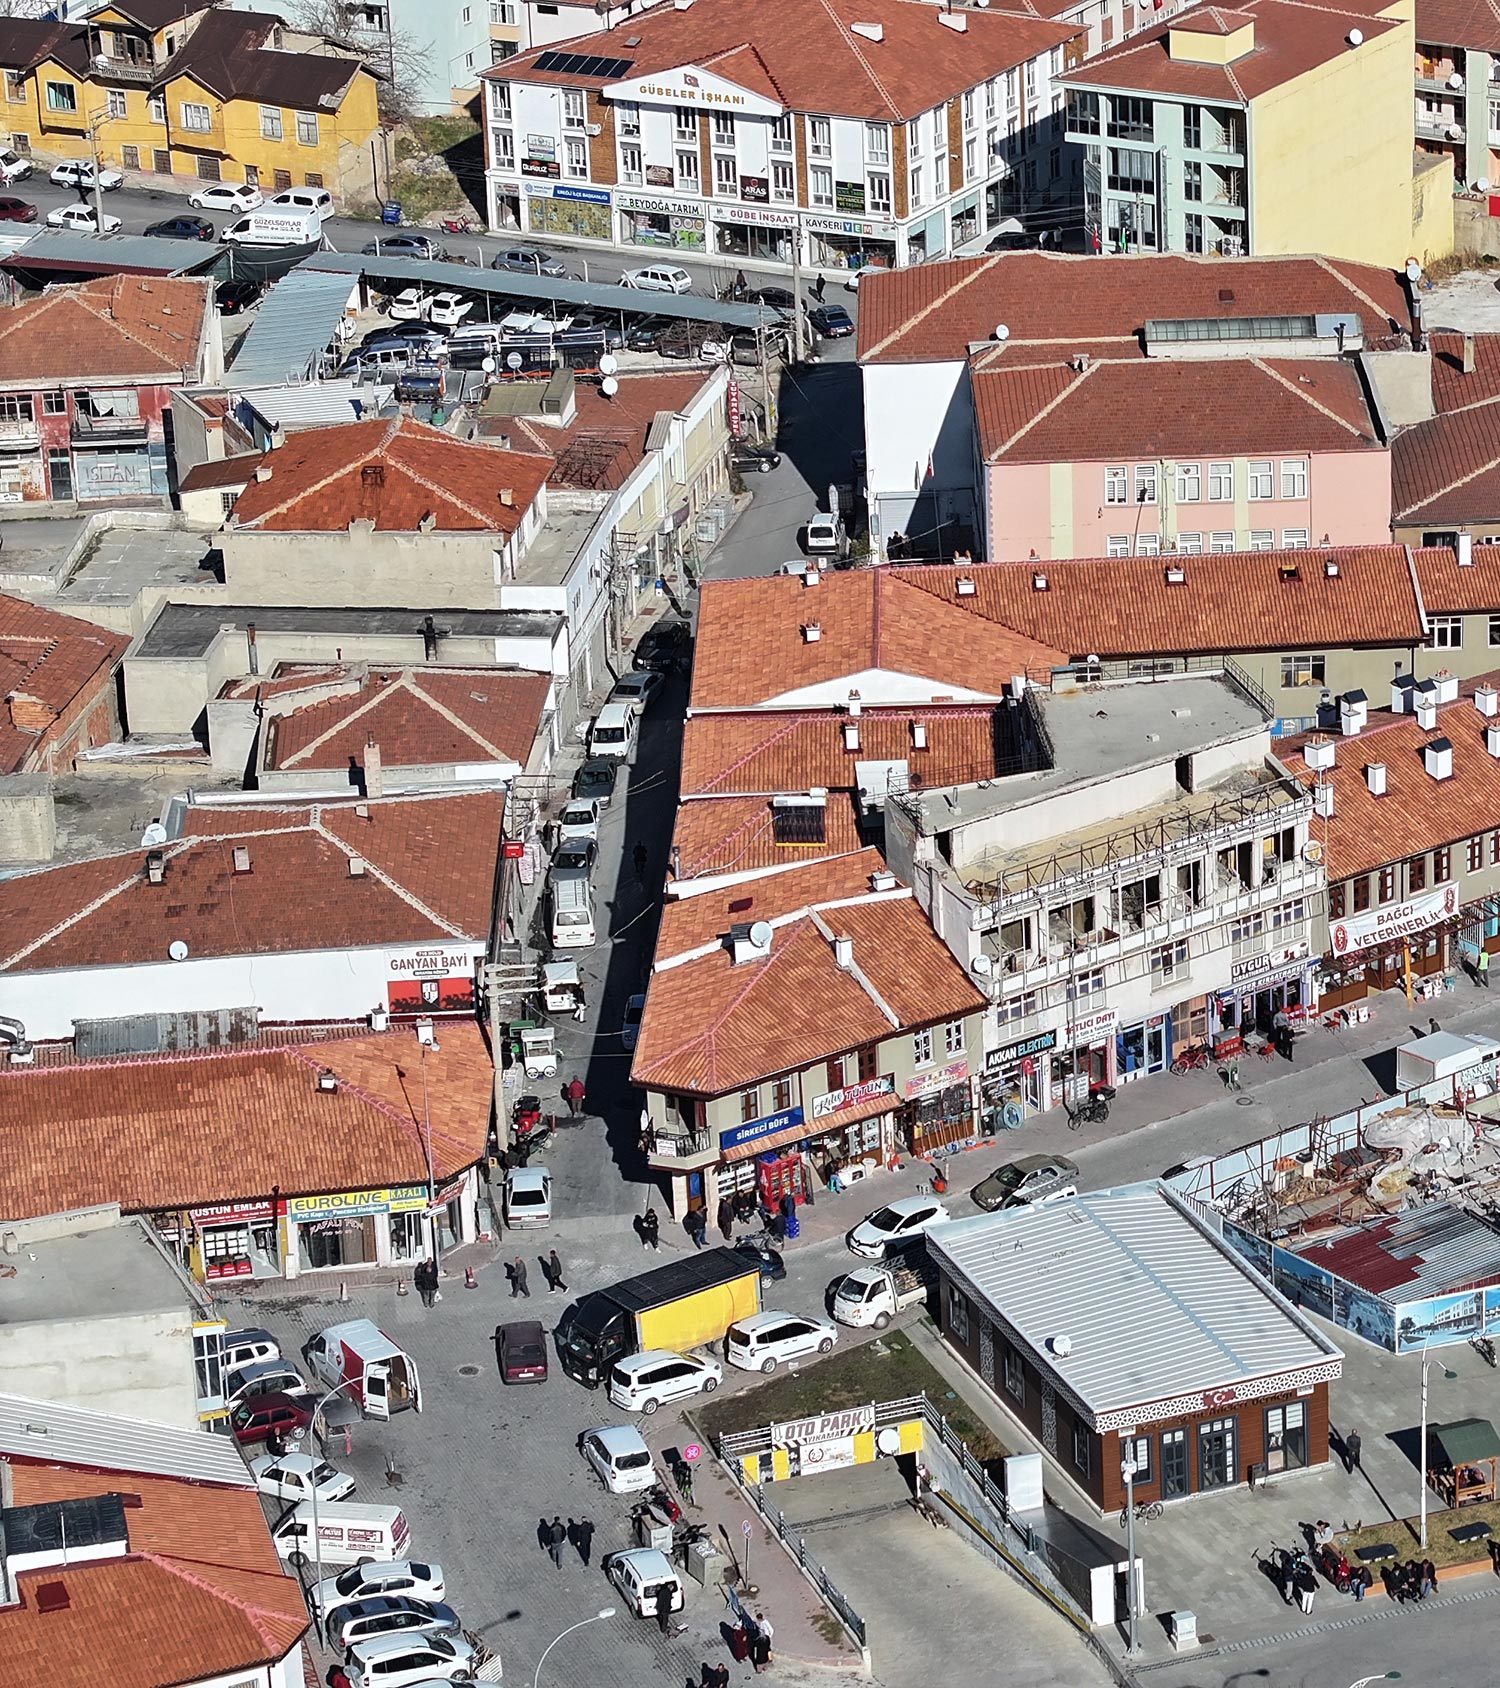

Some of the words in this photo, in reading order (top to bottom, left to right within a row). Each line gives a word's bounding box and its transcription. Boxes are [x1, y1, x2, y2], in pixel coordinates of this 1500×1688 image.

[639, 83, 696, 99] GÜBELER
[701, 89, 745, 105] İŞHANI
[629, 198, 670, 212] BEYDOĞA
[673, 203, 700, 215] TARIM
[730, 209, 757, 219] GÜBE
[759, 210, 795, 224] İNŞAAT
[843, 222, 873, 235] YEM
[1377, 905, 1414, 926] BAĞCI
[390, 957, 438, 970] GANYAN
[442, 953, 467, 967] BAYİ
[1232, 955, 1270, 977] UYGUR
[1096, 1011, 1115, 1024] DAYI
[988, 1047, 1017, 1067] AKKAN
[1018, 1033, 1055, 1056] ELEKTRİK
[845, 1080, 883, 1101] TÜTÜN
[737, 1126, 768, 1140] SİRKECİ
[768, 1116, 789, 1130] BÜFE
[295, 1191, 383, 1211] EUROLINE
[389, 1187, 422, 1199] KAFALI
[233, 1201, 271, 1212] EMLAK
[785, 1421, 816, 1440] OTO
[820, 1411, 863, 1433] PARK
